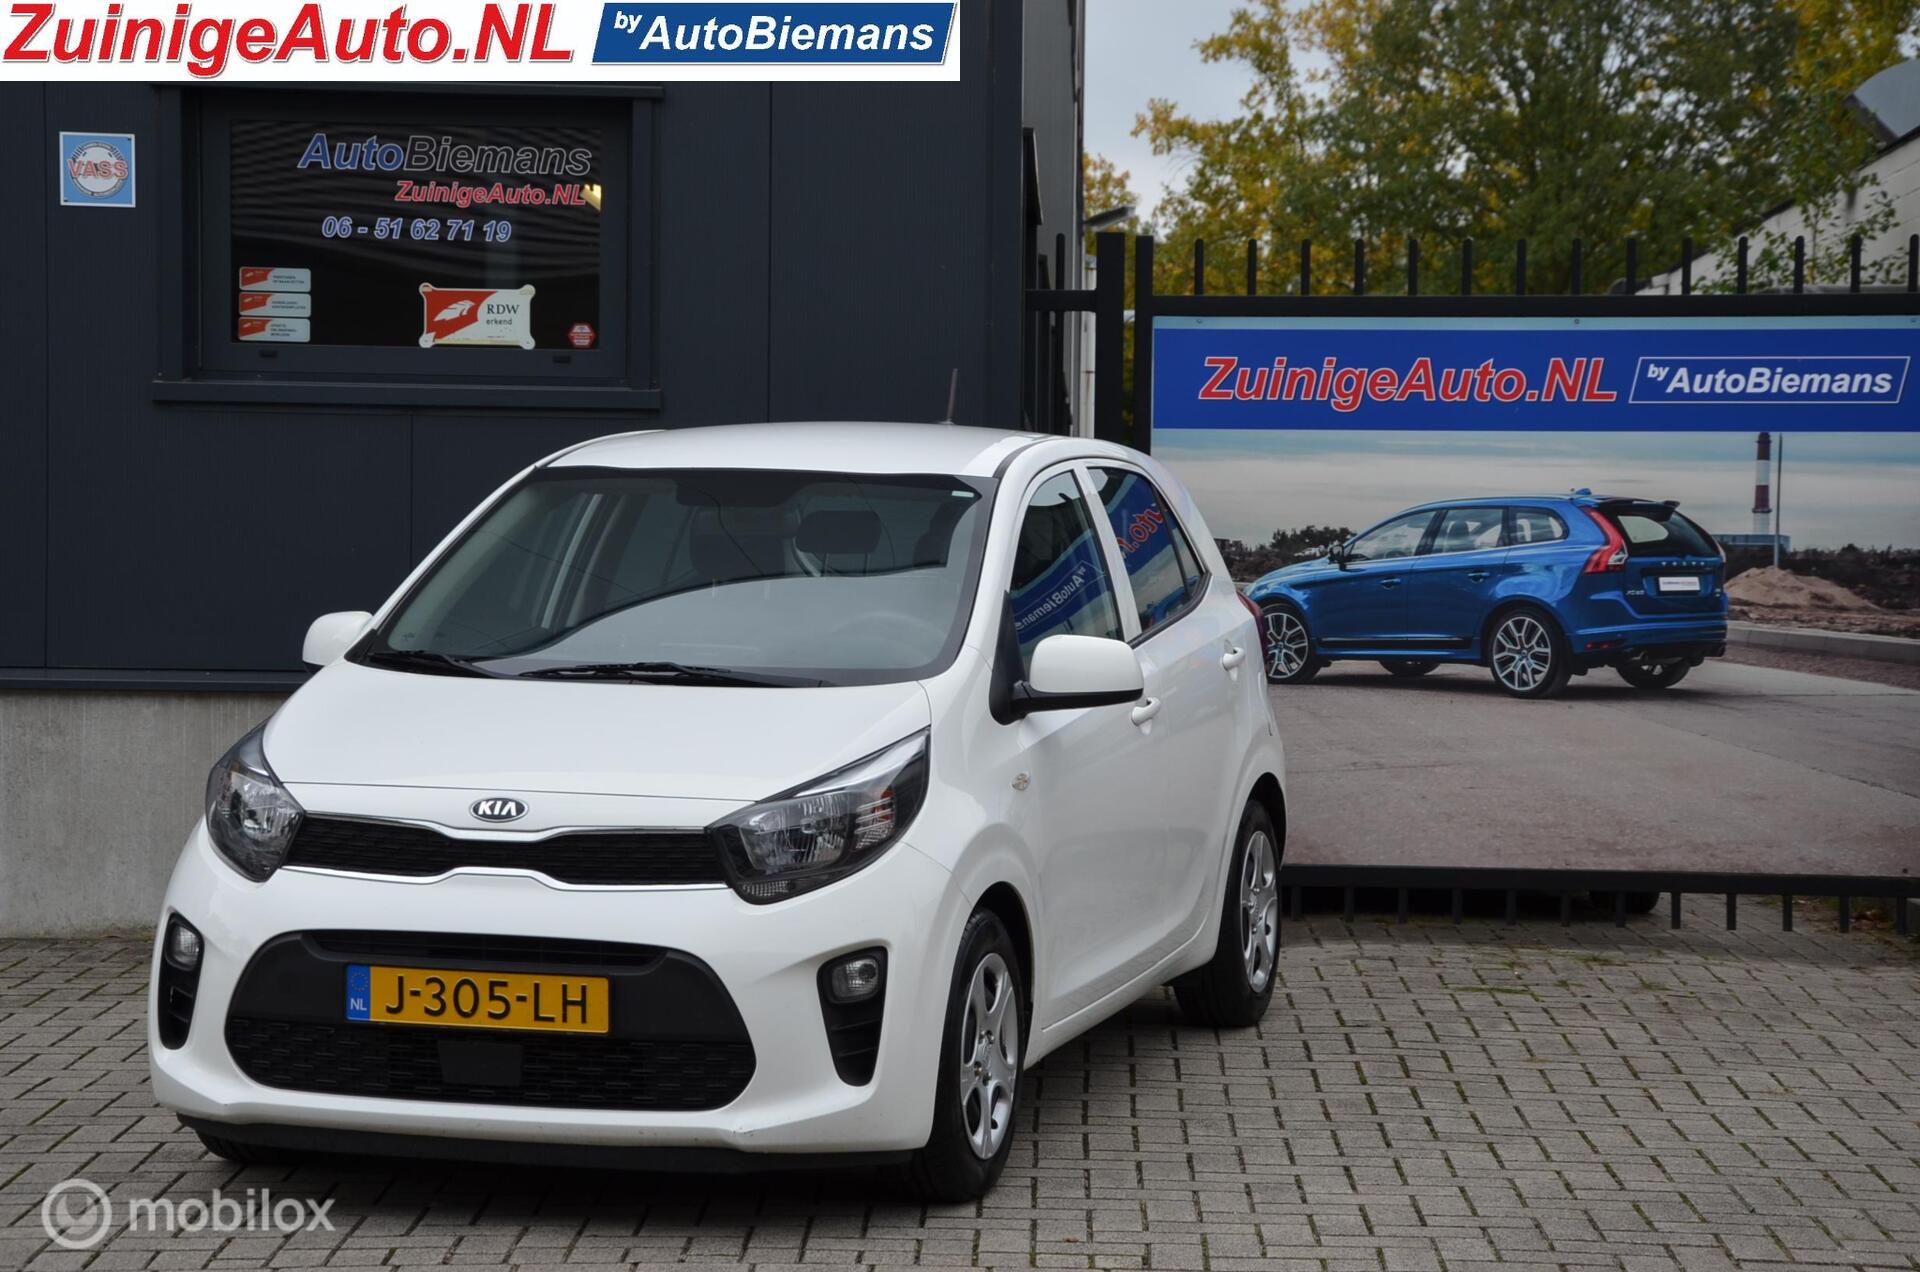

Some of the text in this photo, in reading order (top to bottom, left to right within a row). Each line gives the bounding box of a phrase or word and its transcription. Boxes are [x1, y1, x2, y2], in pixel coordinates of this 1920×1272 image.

[297, 133, 592, 175] AutoBiemans
[67, 159, 129, 179] VASS
[395, 180, 586, 208] ZuinigeAuto.NL
[321, 216, 352, 238] 06
[374, 218, 402, 239] 51
[410, 219, 439, 240] 62
[447, 219, 473, 241] 71
[483, 221, 512, 242] 19
[486, 304, 520, 315] RDW
[486, 318, 513, 326] erkend
[1199, 356, 1617, 412] ZuinigeAuto.NL
[1647, 364, 1893, 394] by AutoBiemans
[478, 800, 517, 816] KIA
[350, 998, 367, 1011] NL
[385, 974, 588, 1025] J-305-LH
